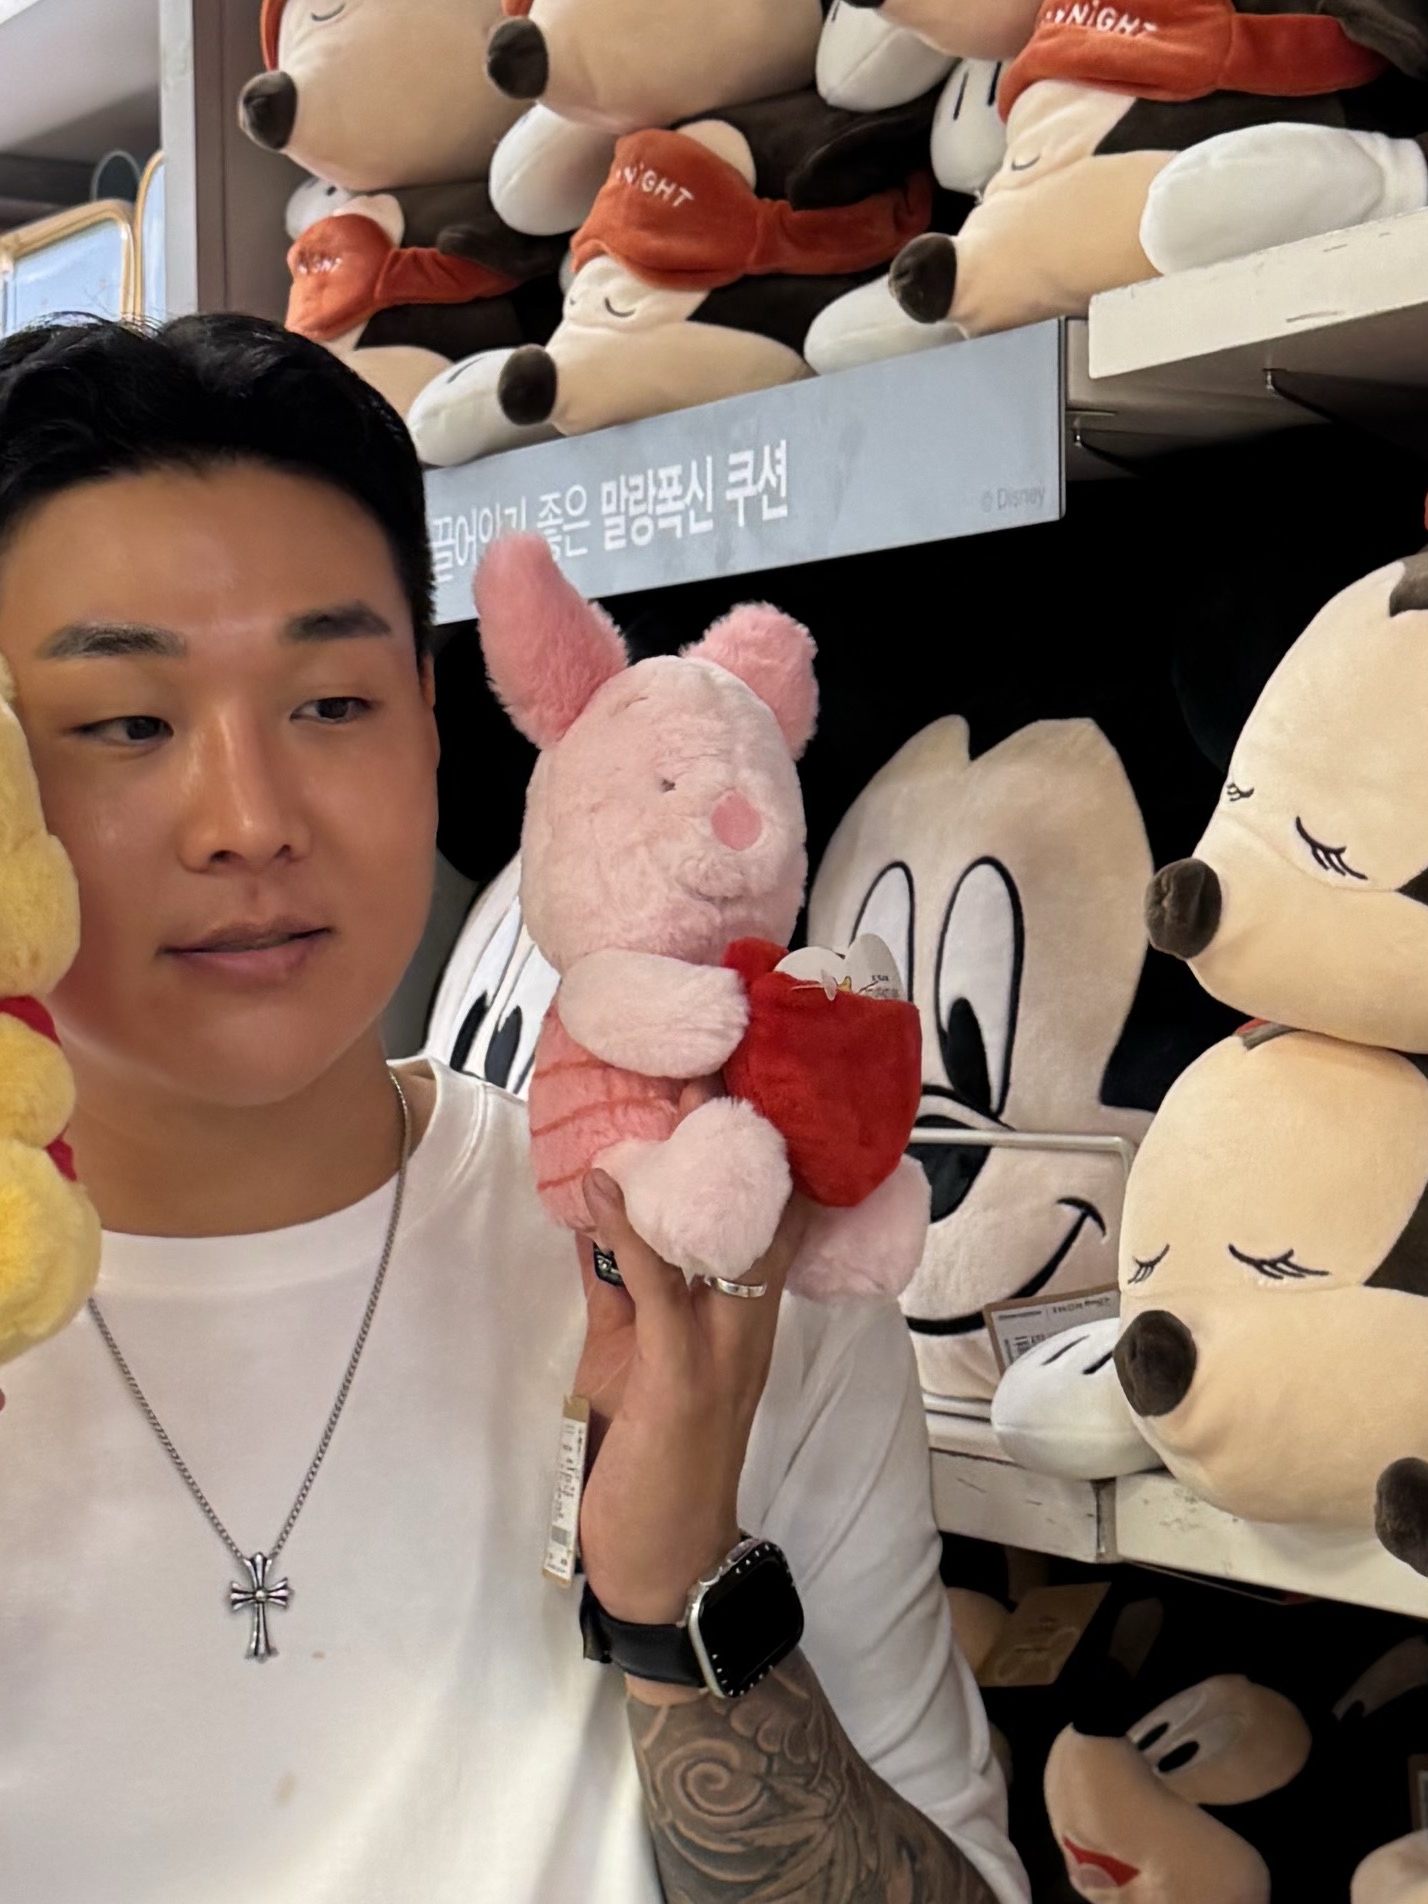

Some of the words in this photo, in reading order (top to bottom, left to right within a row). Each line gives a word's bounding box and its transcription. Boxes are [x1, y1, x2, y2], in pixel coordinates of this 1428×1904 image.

[536, 484, 590, 561] 좋은
[600, 455, 713, 552] 말랑폭신
[725, 439, 788, 528] 쿠션
